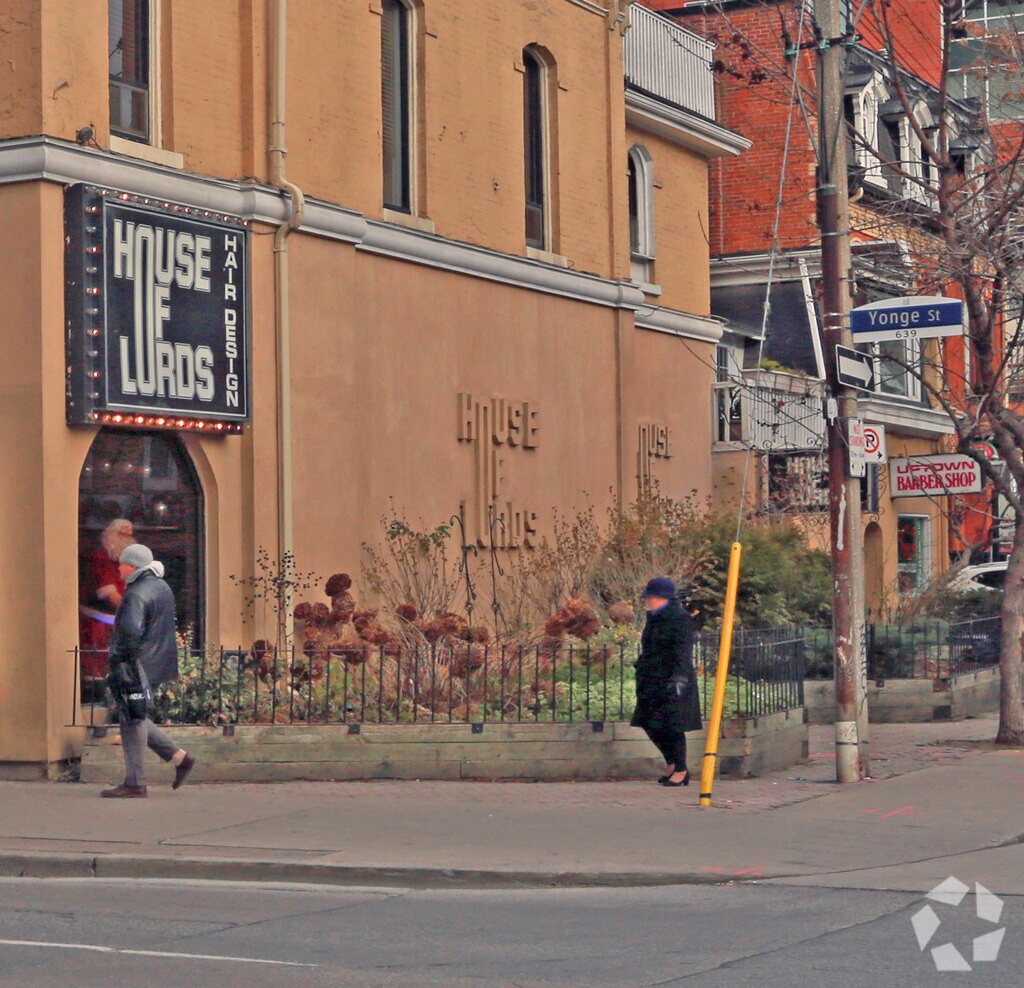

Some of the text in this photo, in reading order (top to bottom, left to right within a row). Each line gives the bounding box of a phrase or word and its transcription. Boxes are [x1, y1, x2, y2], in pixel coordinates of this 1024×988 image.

[113, 218, 212, 292] HOUSE
[224, 234, 239, 407] HAIR DESIGN
[868, 309, 941, 327] Yonge St
[895, 329, 917, 339] 639
[119, 335, 215, 402] LORDS
[457, 392, 539, 451] HOUSE
[896, 460, 975, 474] UPTOWN
[897, 471, 976, 491] BARBER SHOP
